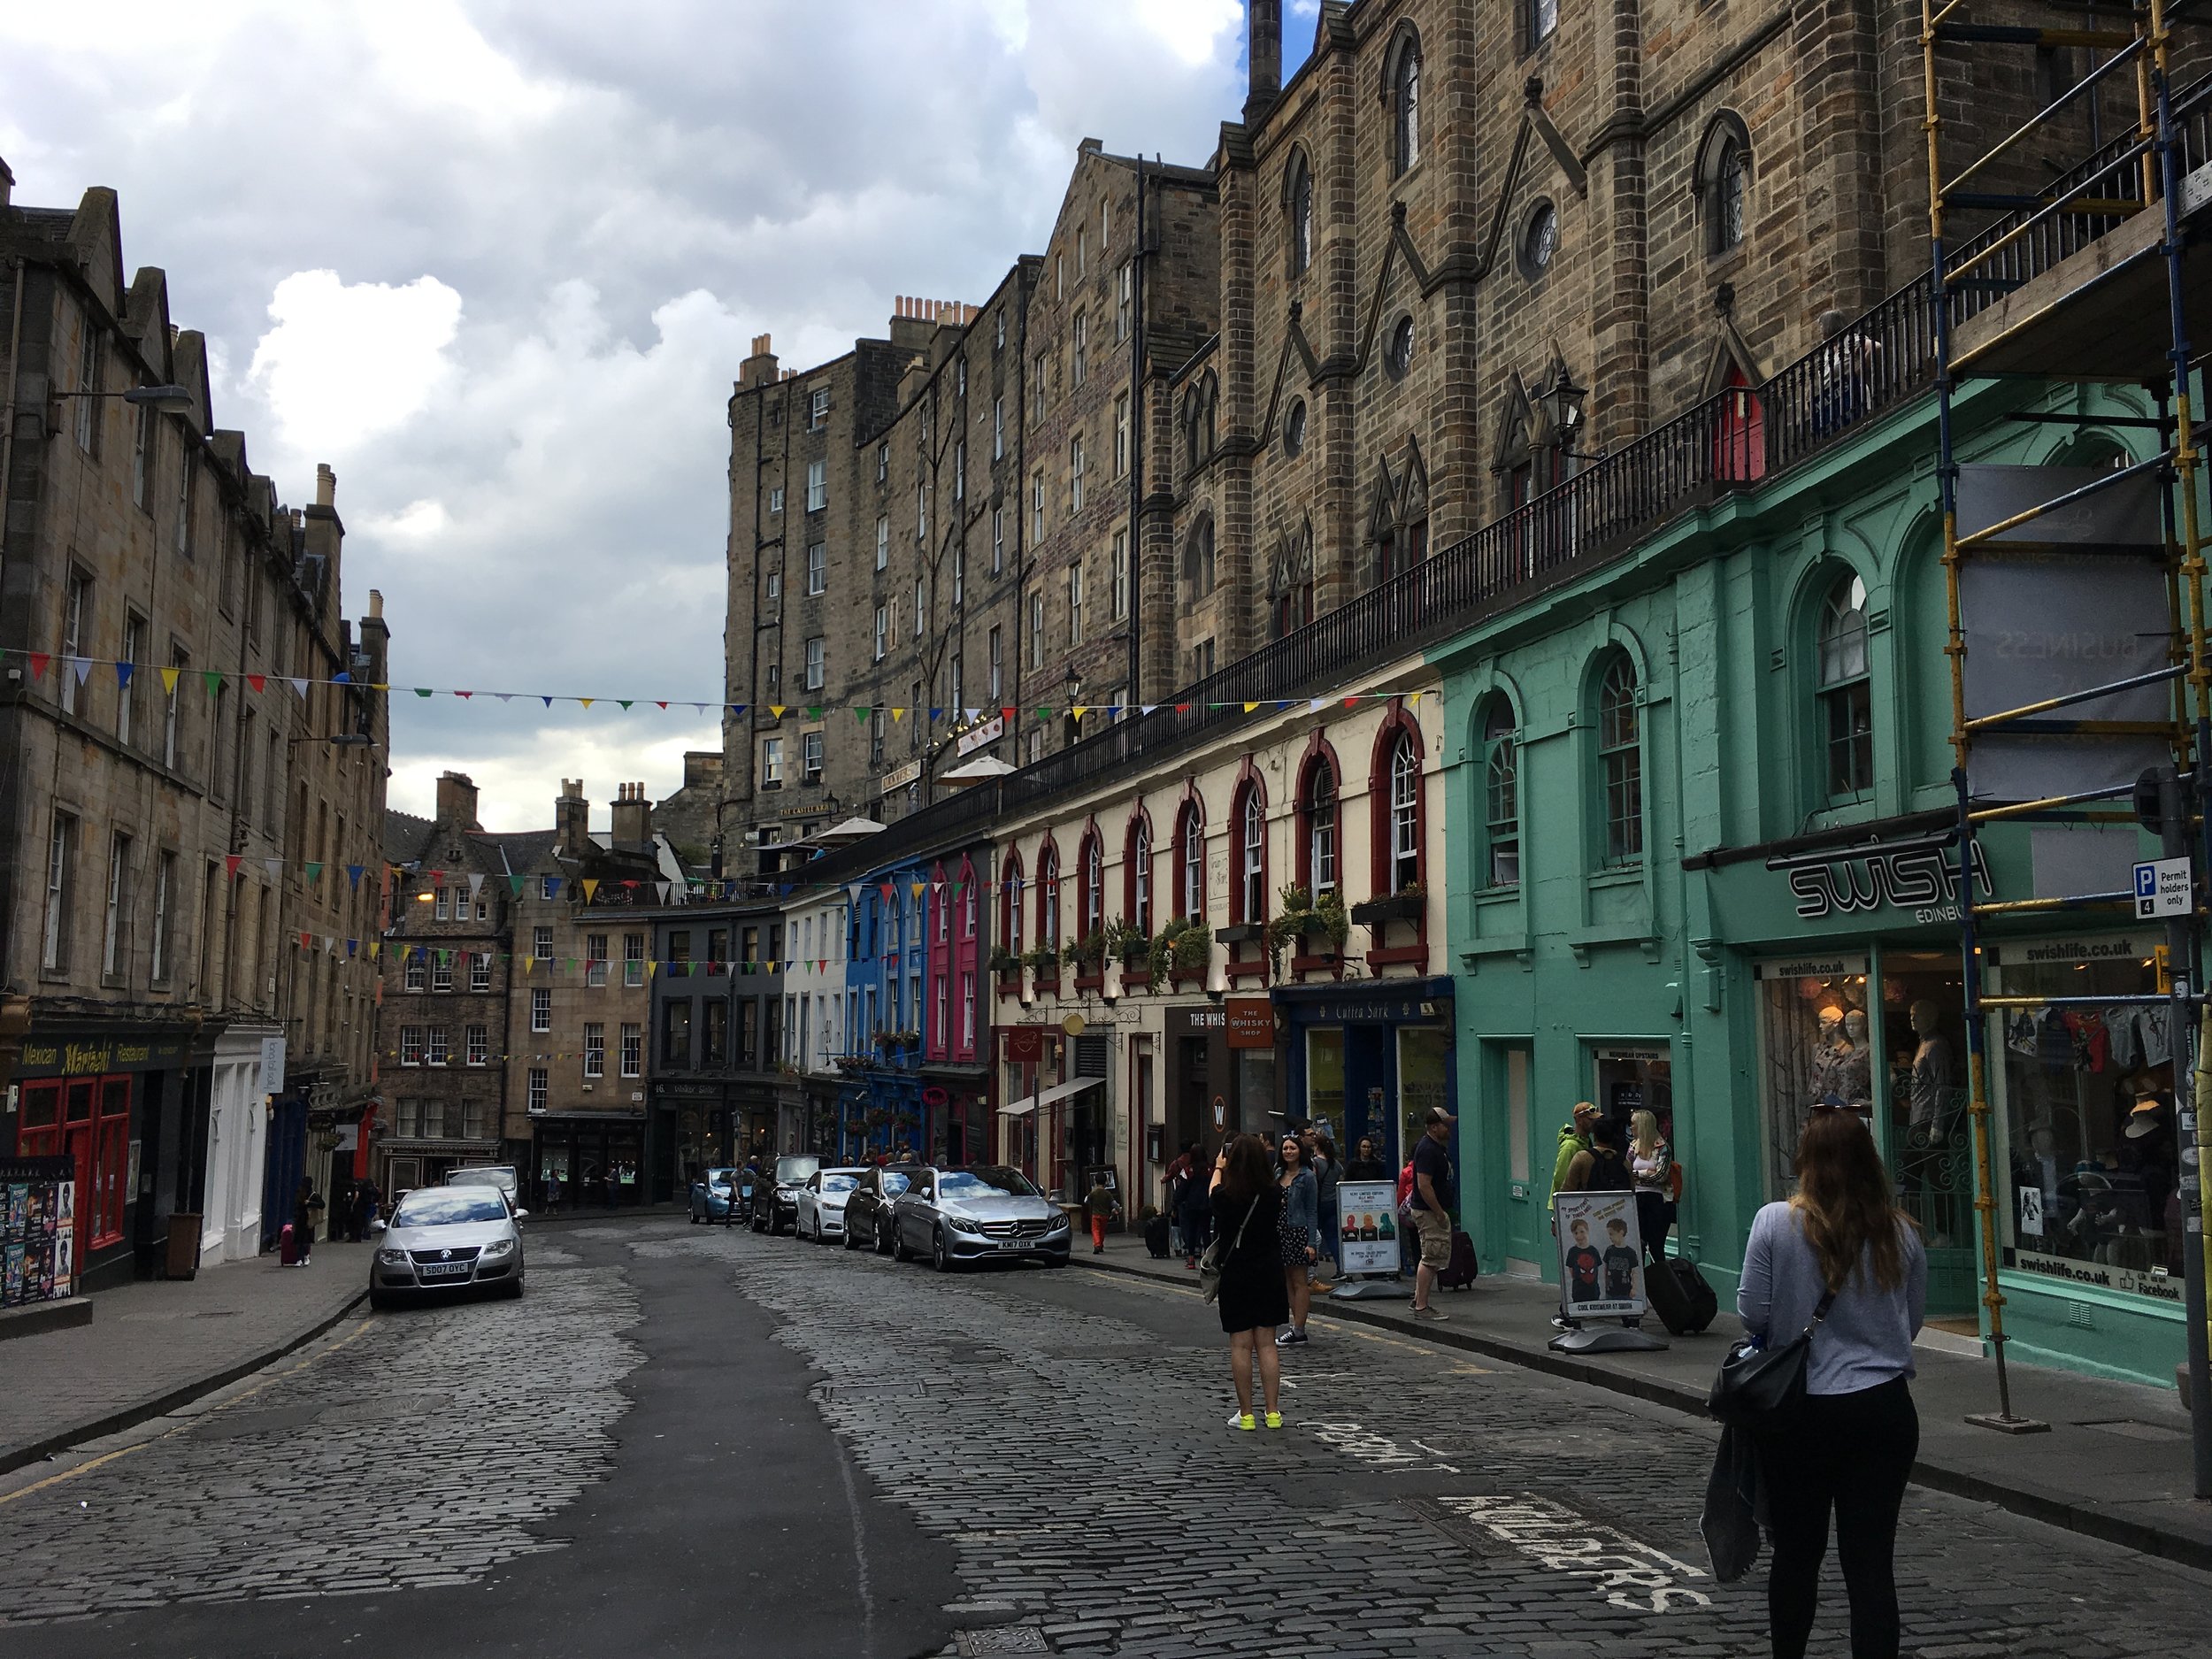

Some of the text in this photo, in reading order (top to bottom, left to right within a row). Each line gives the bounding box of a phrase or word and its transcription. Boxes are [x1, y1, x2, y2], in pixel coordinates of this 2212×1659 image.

[793, 805, 814, 814] CASTLE
[2140, 870, 2153, 894] P
[2161, 870, 2187, 882] Permit
[2160, 883, 2189, 895] holders
[2144, 902, 2151, 912] 4
[2167, 895, 2184, 906] only
[2026, 939, 2132, 961] swishlife.co.uk
[1778, 960, 1845, 977] swishlife.co.uk
[1335, 1001, 1388, 1019] Cuttea Sark
[1190, 1013, 1204, 1026] THE
[22, 1035, 150, 1076] Mexican Mariachi Restaurant
[1214, 1105, 1224, 1125] W
[426, 1263, 465, 1275] SD07 OYC
[2020, 1257, 2110, 1286] swishlife.co.uk
[2138, 1282, 2180, 1300] Facebook
